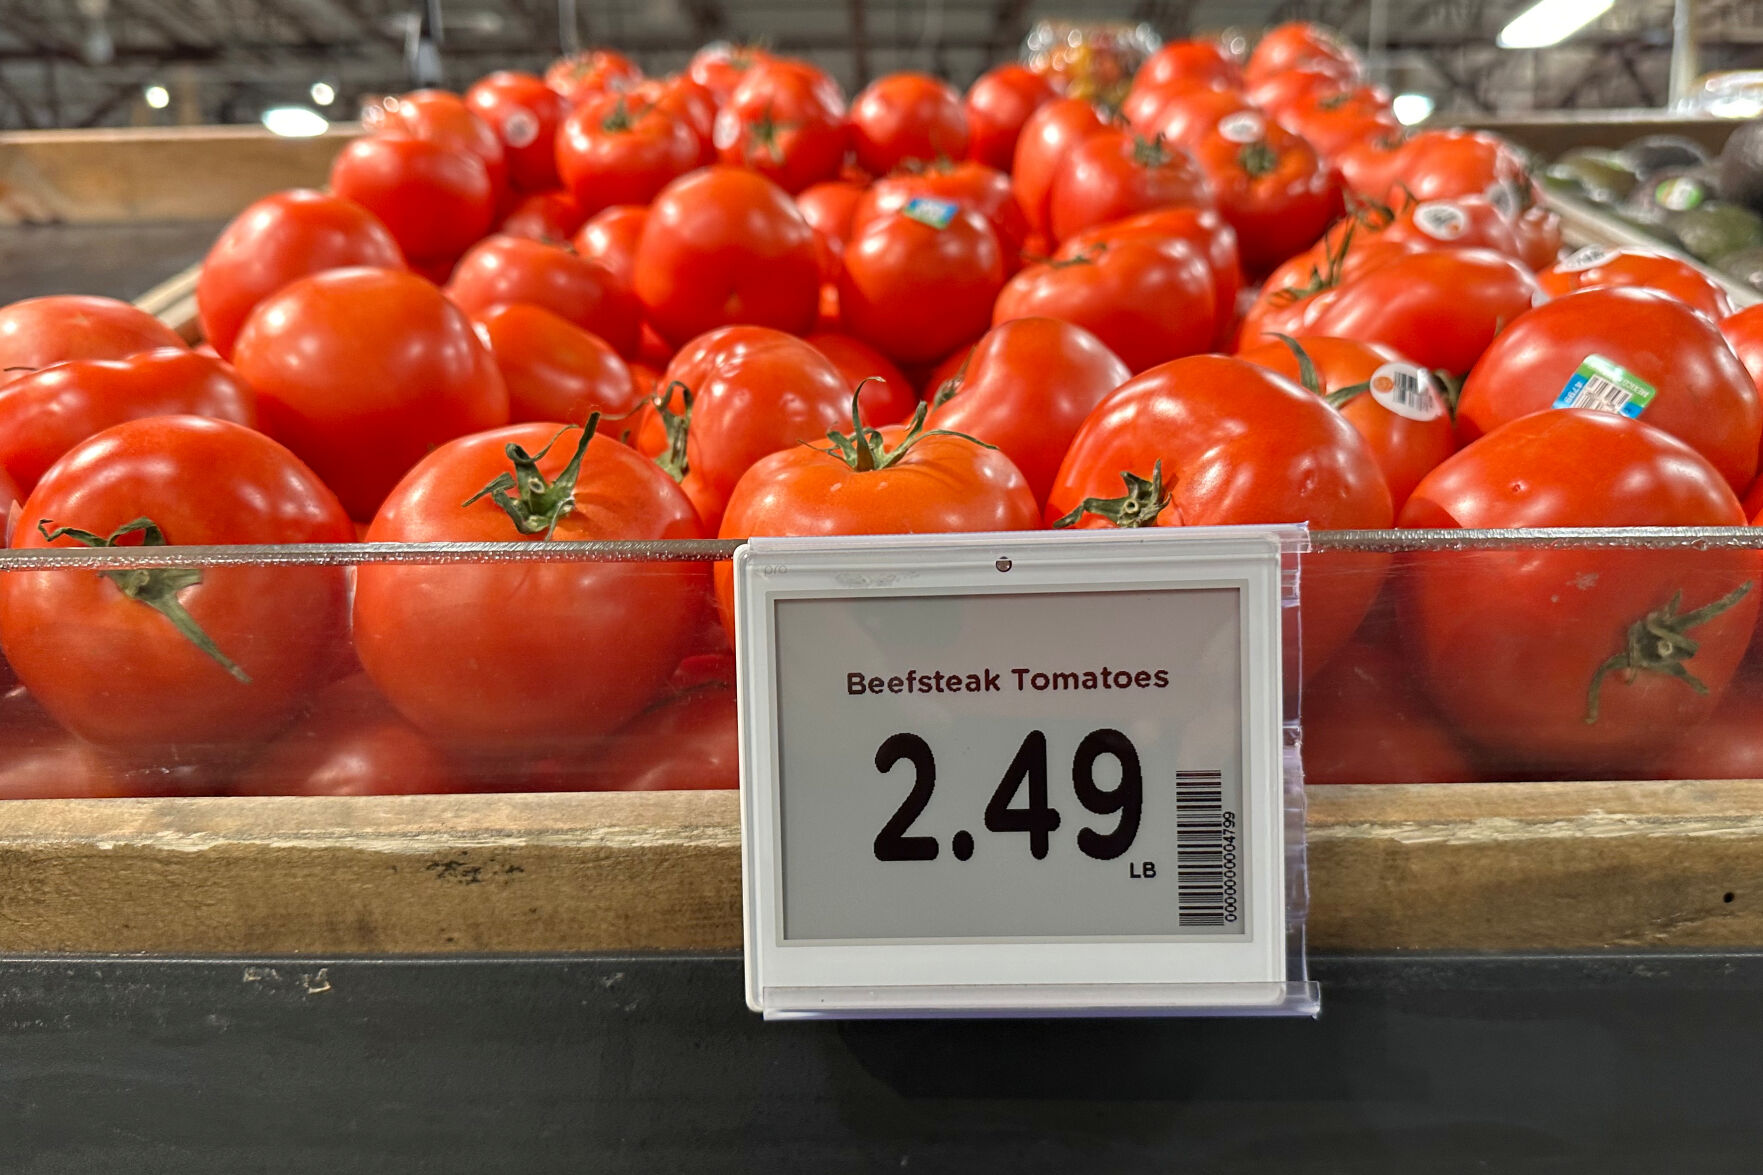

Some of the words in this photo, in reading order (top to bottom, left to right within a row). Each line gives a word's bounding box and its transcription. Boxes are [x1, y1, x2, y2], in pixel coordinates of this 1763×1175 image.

[1621, 378, 1650, 398] MEXICO
[847, 668, 1000, 695] Beefsteak
[1010, 666, 1169, 691] Tomatoes
[873, 728, 1143, 861] 2.49
[1129, 861, 1157, 878] LB
[1222, 811, 1237, 922] 0000000004799
